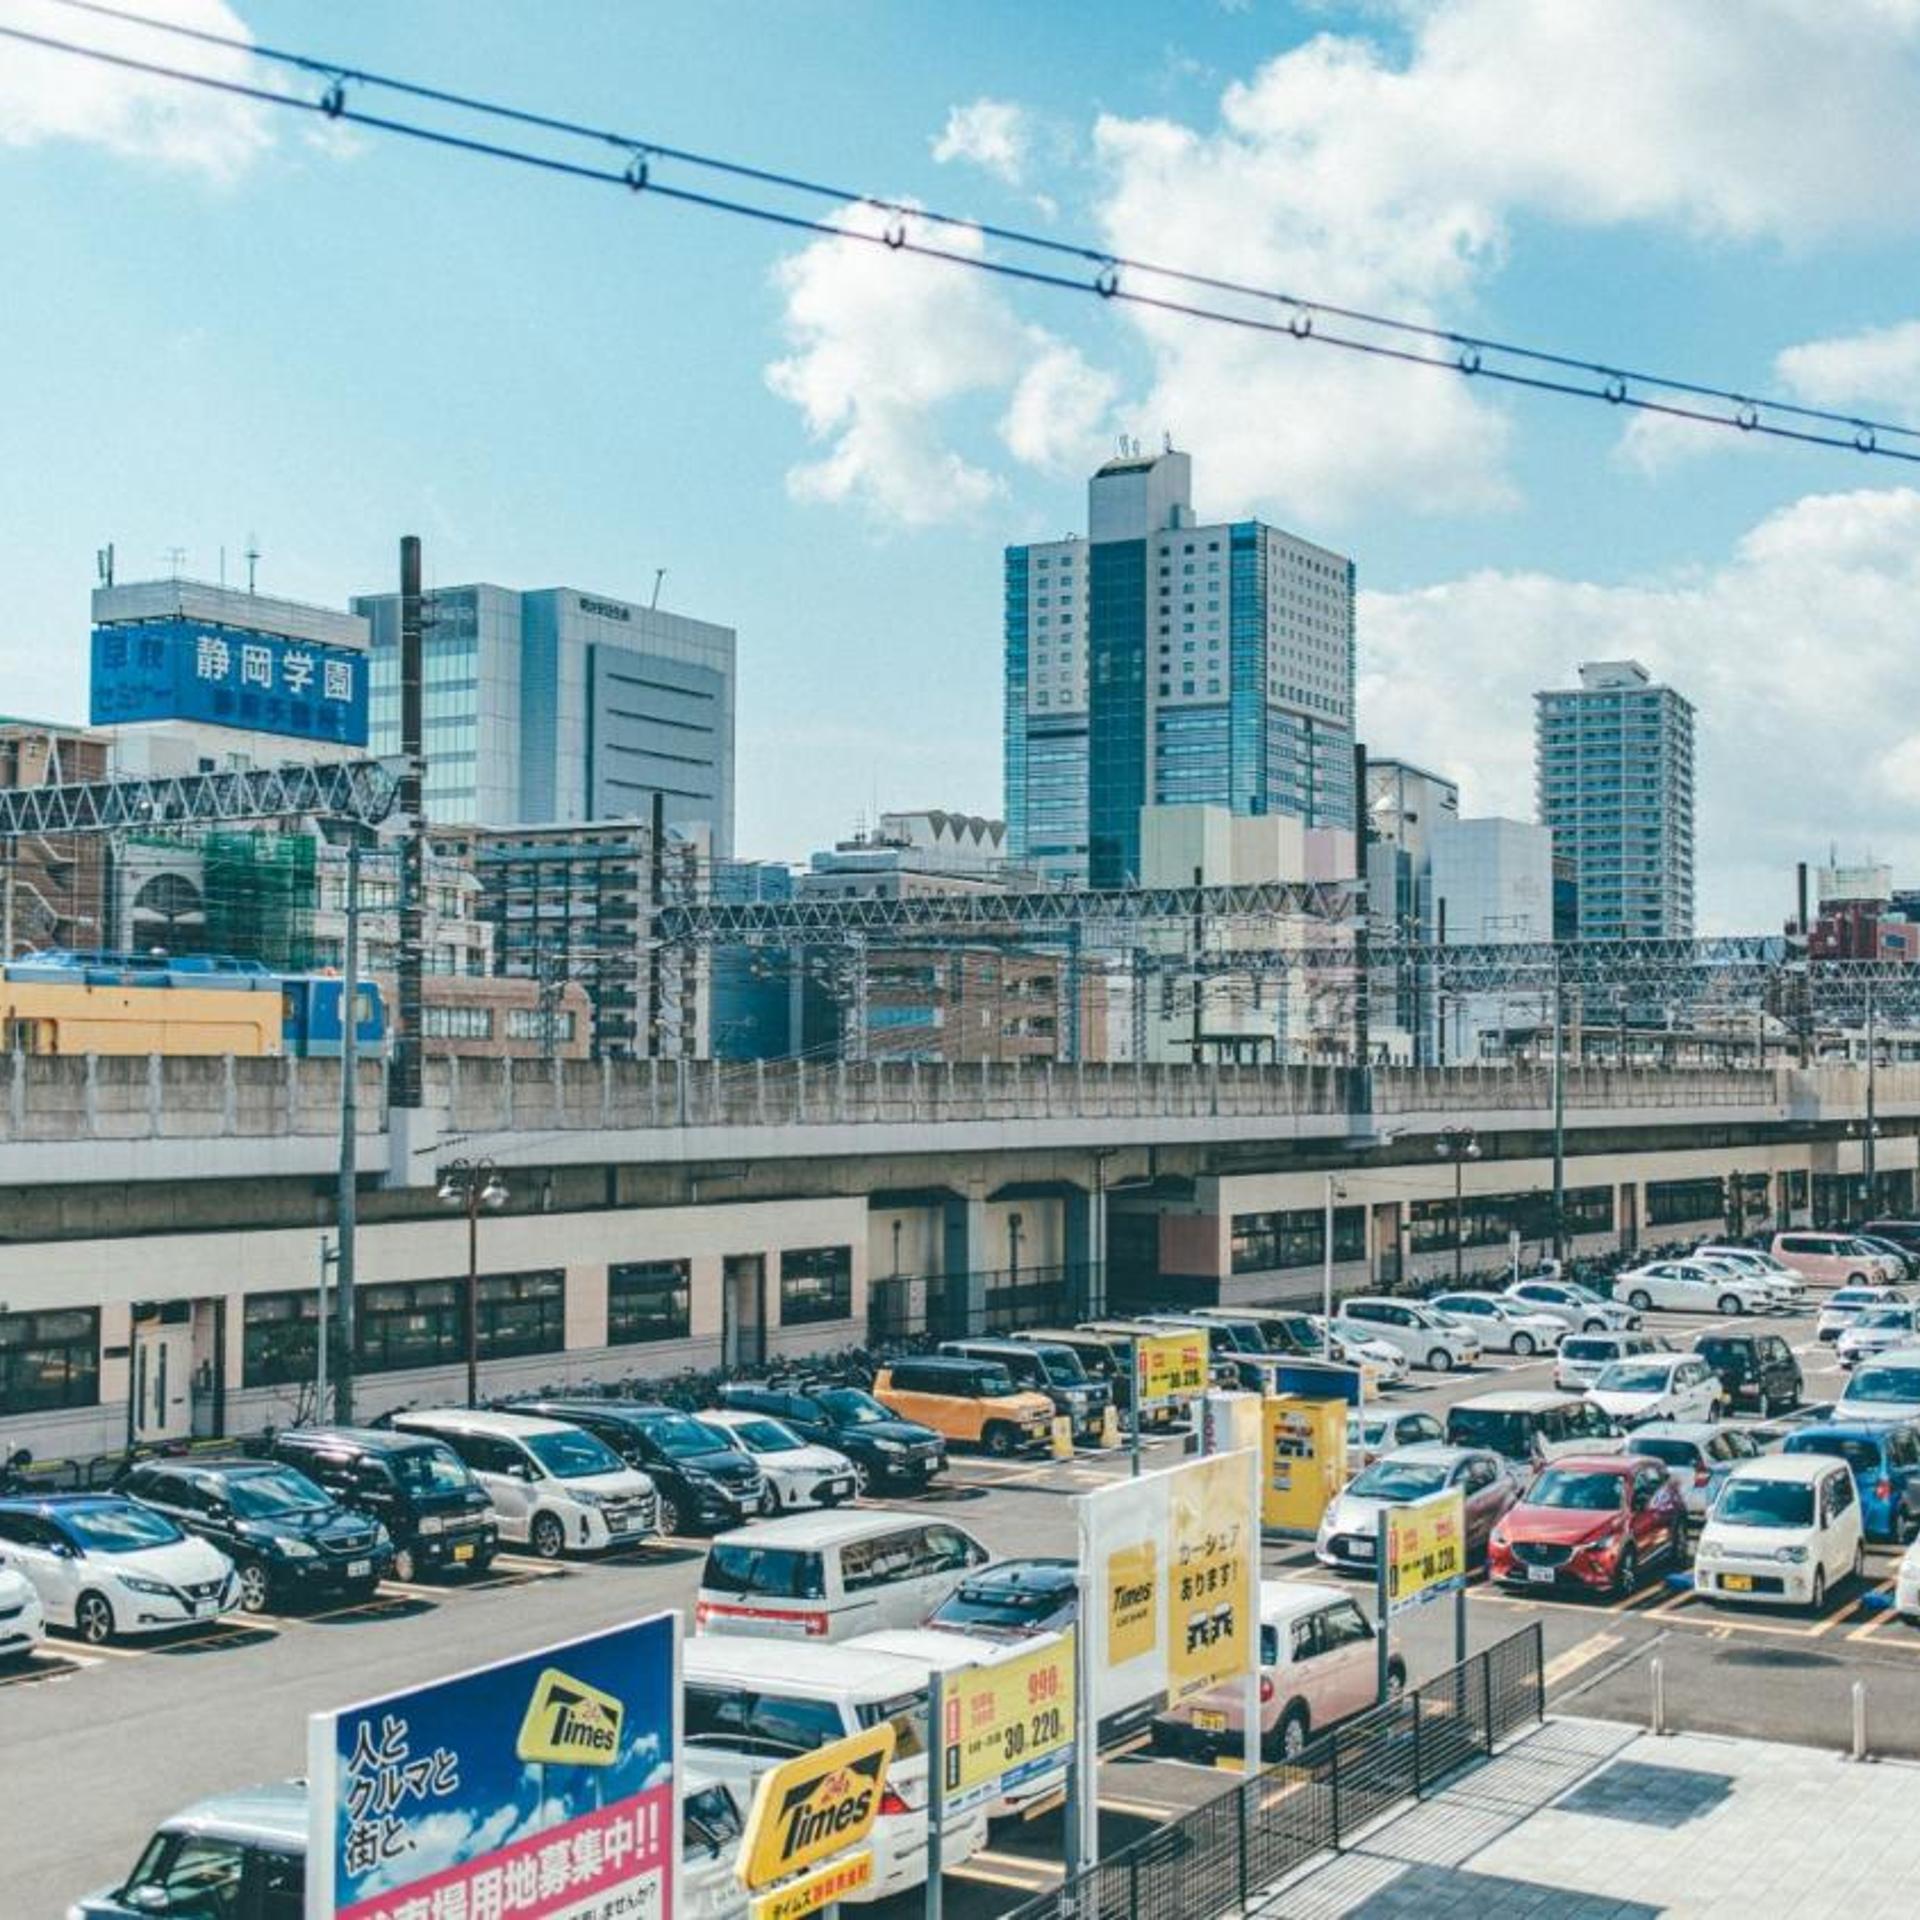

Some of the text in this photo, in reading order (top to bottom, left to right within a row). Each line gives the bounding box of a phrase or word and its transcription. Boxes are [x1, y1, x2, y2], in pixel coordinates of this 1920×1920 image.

[197, 636, 353, 702] 静岡学園
[1113, 1582, 1153, 1612] Times
[348, 1715, 408, 1774] 人と
[544, 1684, 618, 1750] Times
[1032, 1708, 1059, 1748] 220
[347, 1748, 459, 1820] クルマと
[778, 1750, 885, 1862] Times
[347, 1815, 417, 1875] 街と、
[363, 1801, 660, 1920] 場用地募集中!!
